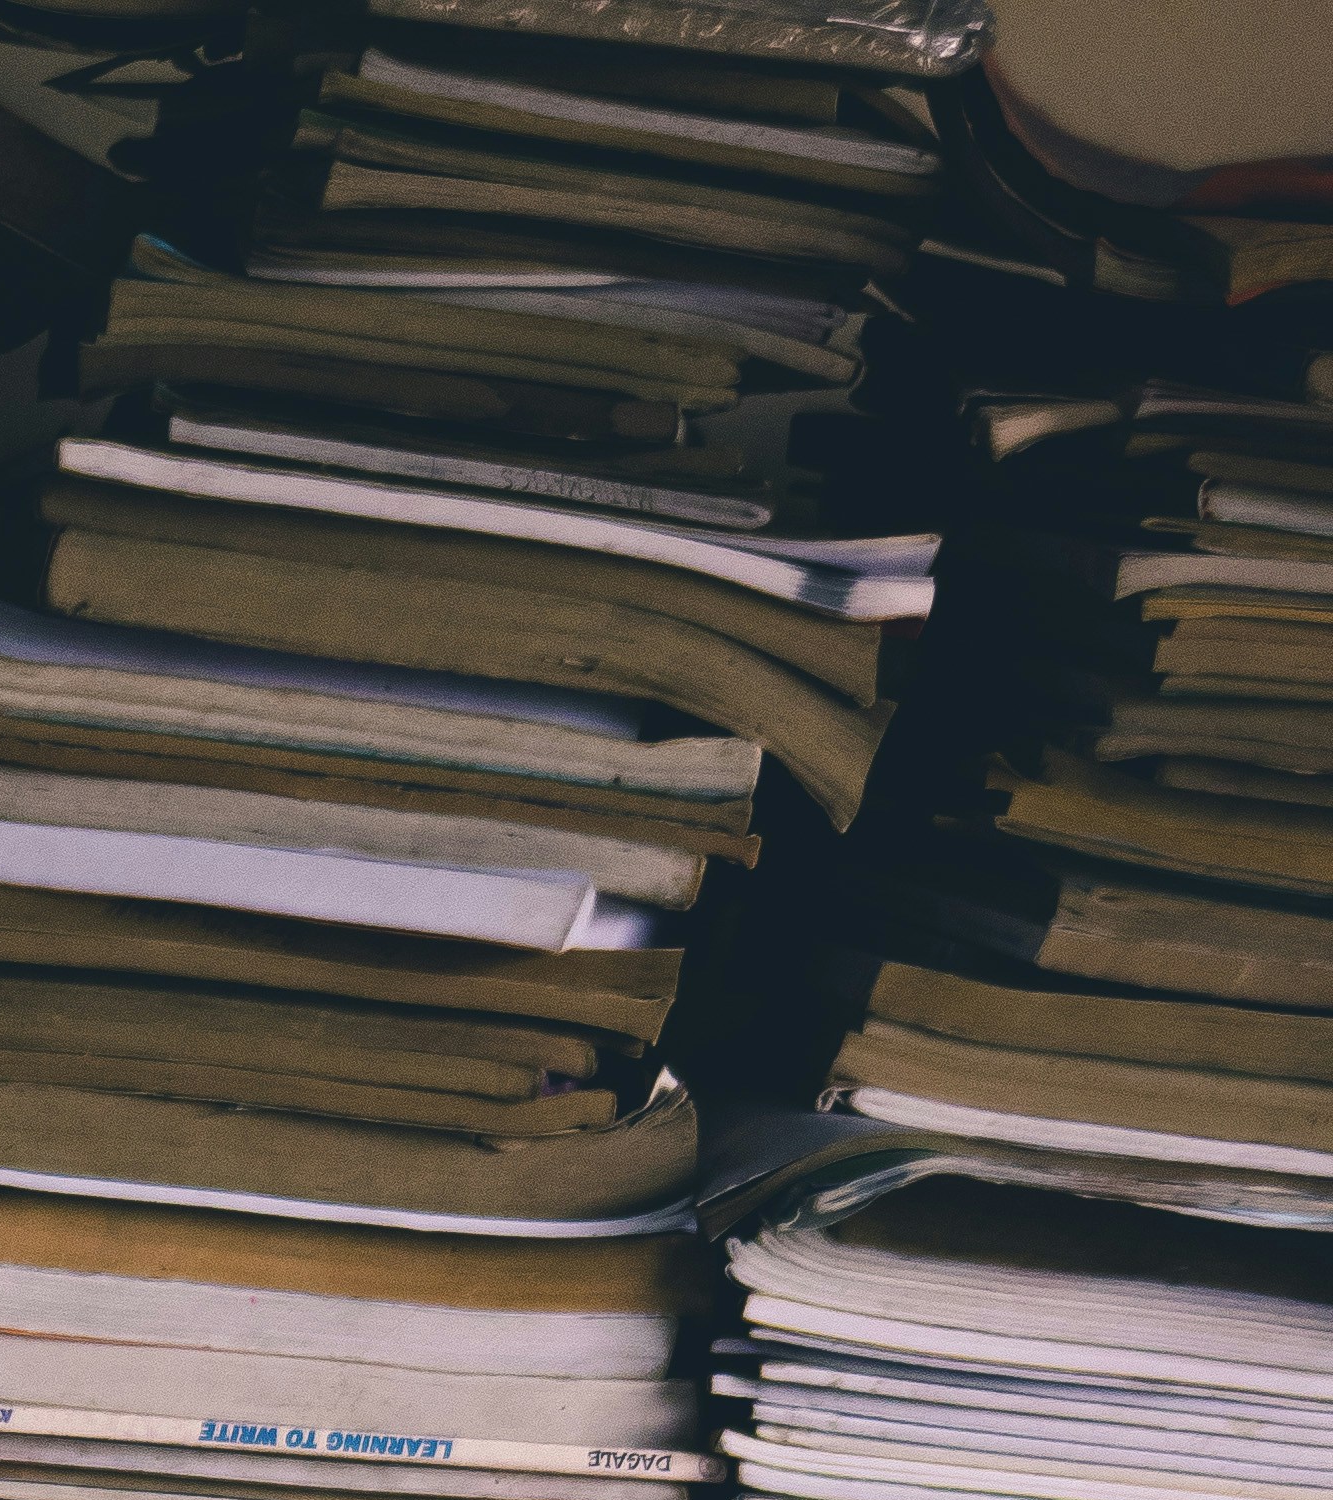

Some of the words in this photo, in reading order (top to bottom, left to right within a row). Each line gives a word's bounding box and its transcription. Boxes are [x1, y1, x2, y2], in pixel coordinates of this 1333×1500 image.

[198, 1421, 278, 1447] WRITE
[285, 1429, 318, 1450] TO
[326, 1432, 453, 1460] LEARNING
[587, 1450, 673, 1472] DAGALE
